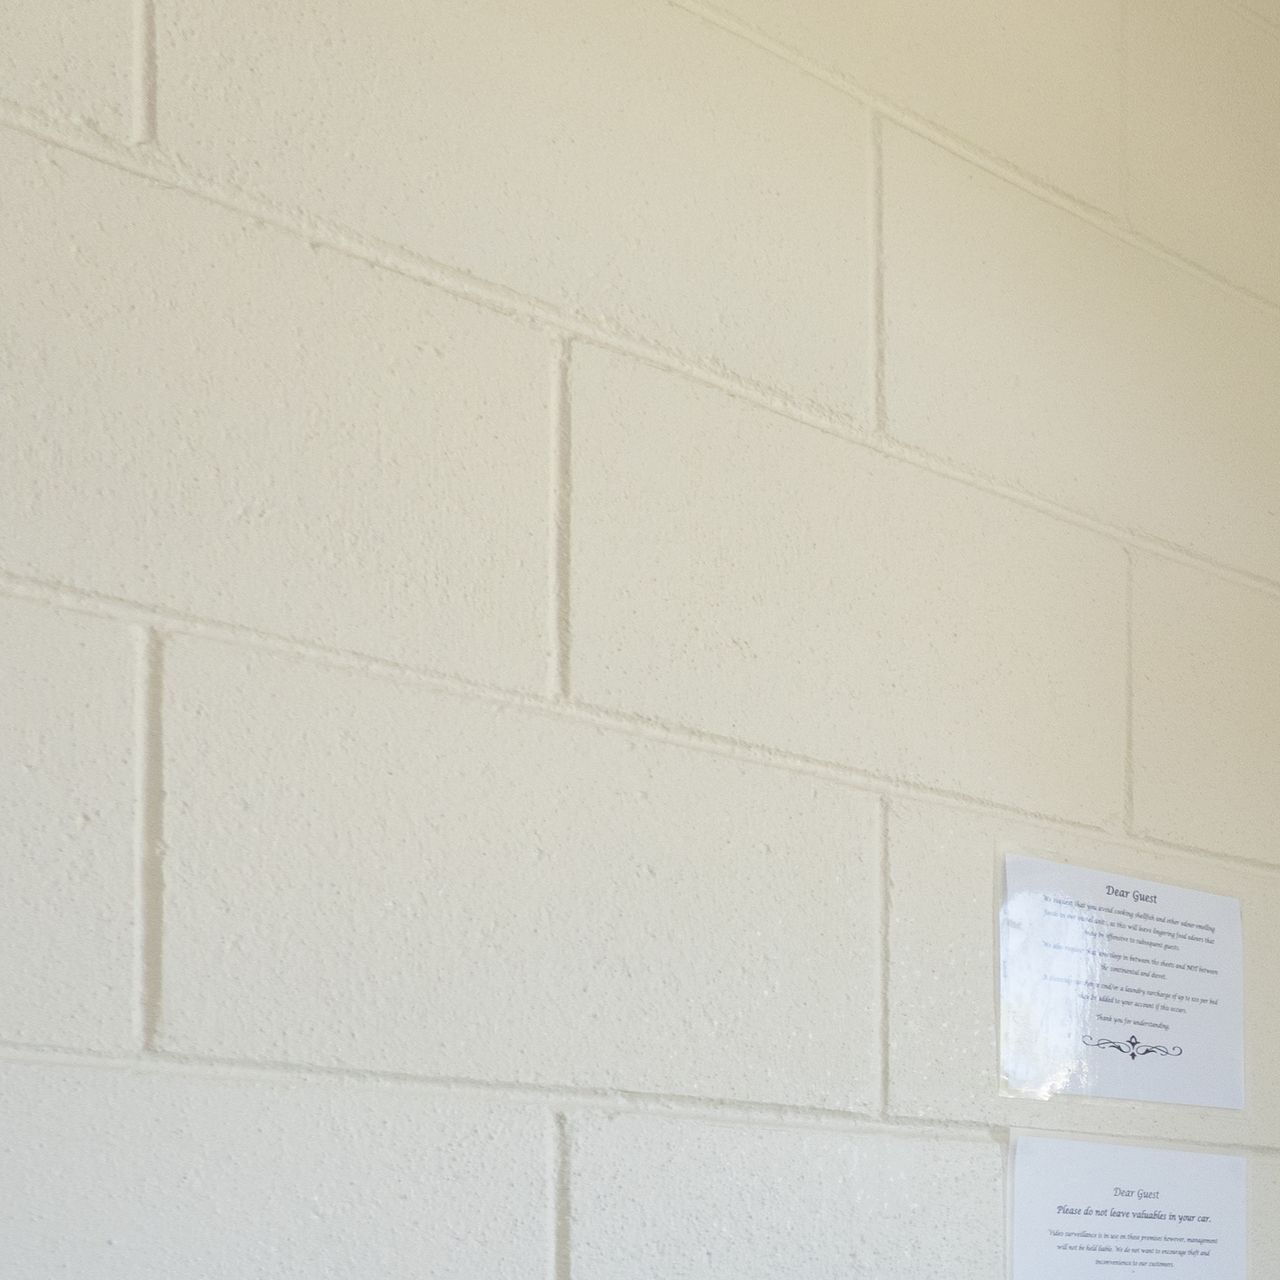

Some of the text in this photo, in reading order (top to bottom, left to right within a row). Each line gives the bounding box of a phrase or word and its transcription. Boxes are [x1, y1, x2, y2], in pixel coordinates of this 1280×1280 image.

[1106, 885, 1157, 903] Dear Guest
[1087, 904, 1096, 912] you
[1114, 908, 1133, 919] cooking
[1153, 928, 1175, 938] lingering
[1130, 955, 1150, 963] between
[1160, 960, 1174, 968] sheets
[1187, 964, 1199, 972] NOT
[1199, 966, 1218, 974] between
[1125, 985, 1145, 996] laundry
[1099, 995, 1114, 1003] added
[1096, 1013, 1112, 1021] Thank
[1113, 1187, 1160, 1200] Dear Guest
[1057, 1204, 1211, 1224] Please do not leave valuables in your car.
[1048, 1229, 1064, 1237] Video
[1065, 1230, 1097, 1238] surveillance
[1187, 1237, 1218, 1245] management
[1086, 1243, 1097, 1252] held
[1162, 1249, 1186, 1257] encourage
[1187, 1248, 1199, 1257] theft
